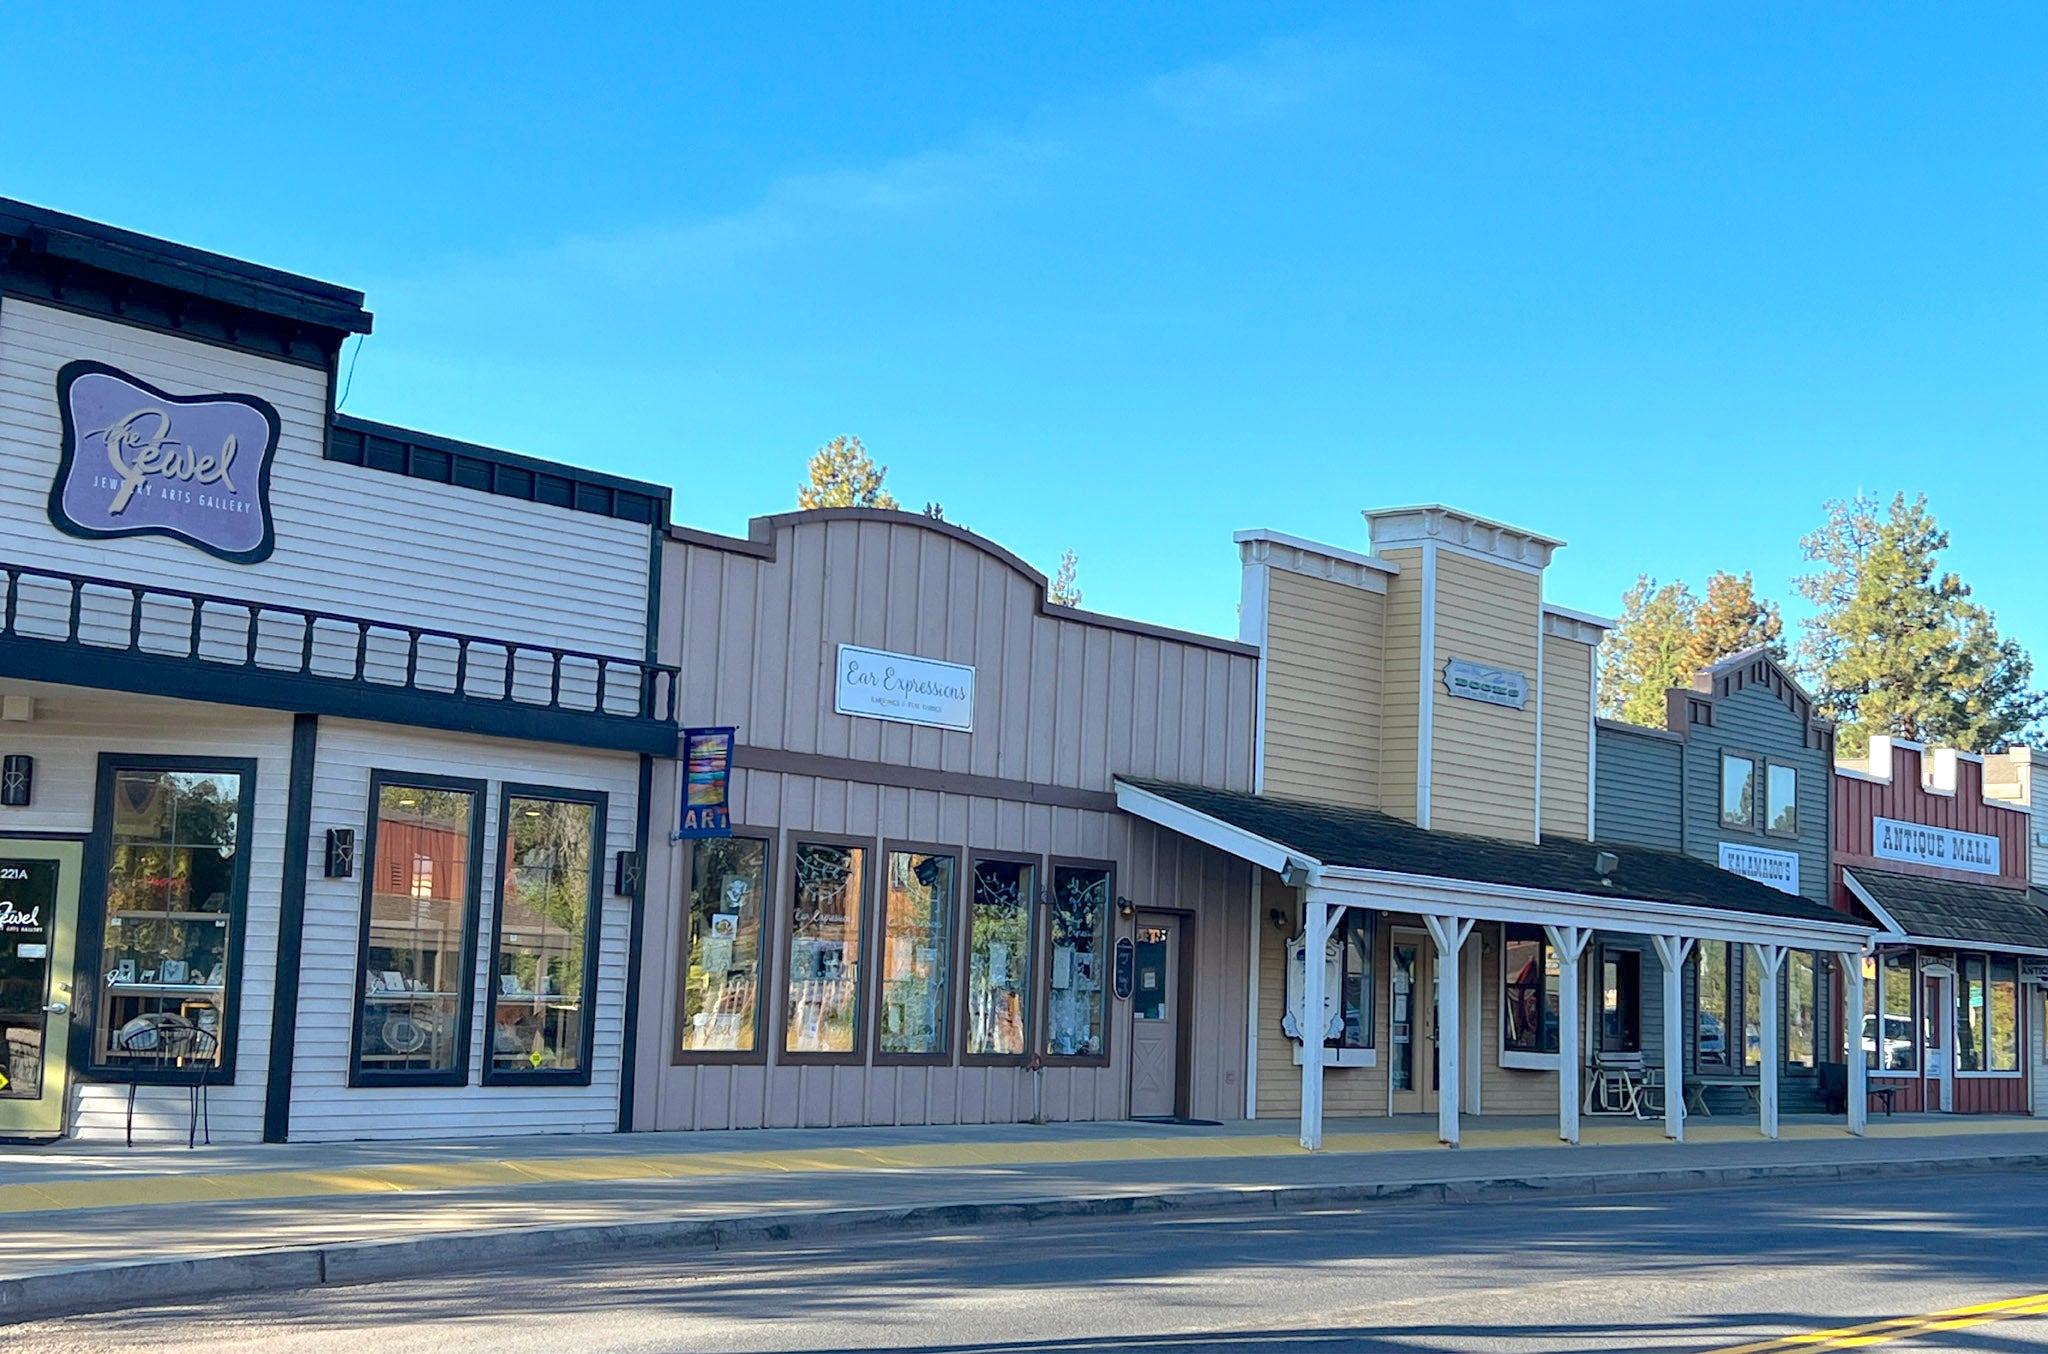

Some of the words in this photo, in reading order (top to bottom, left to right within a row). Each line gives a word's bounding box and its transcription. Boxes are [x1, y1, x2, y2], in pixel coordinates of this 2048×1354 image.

[107, 408, 238, 516] Jewel
[93, 476, 153, 497] JEWRY
[162, 488, 191, 504] ARTS
[199, 494, 252, 514] GALLERY
[846, 660, 879, 686] Ear
[883, 666, 966, 701] Expressions
[685, 807, 728, 830] ART
[1883, 825, 1945, 859] ANTIQUE
[1952, 837, 1992, 865] MALL
